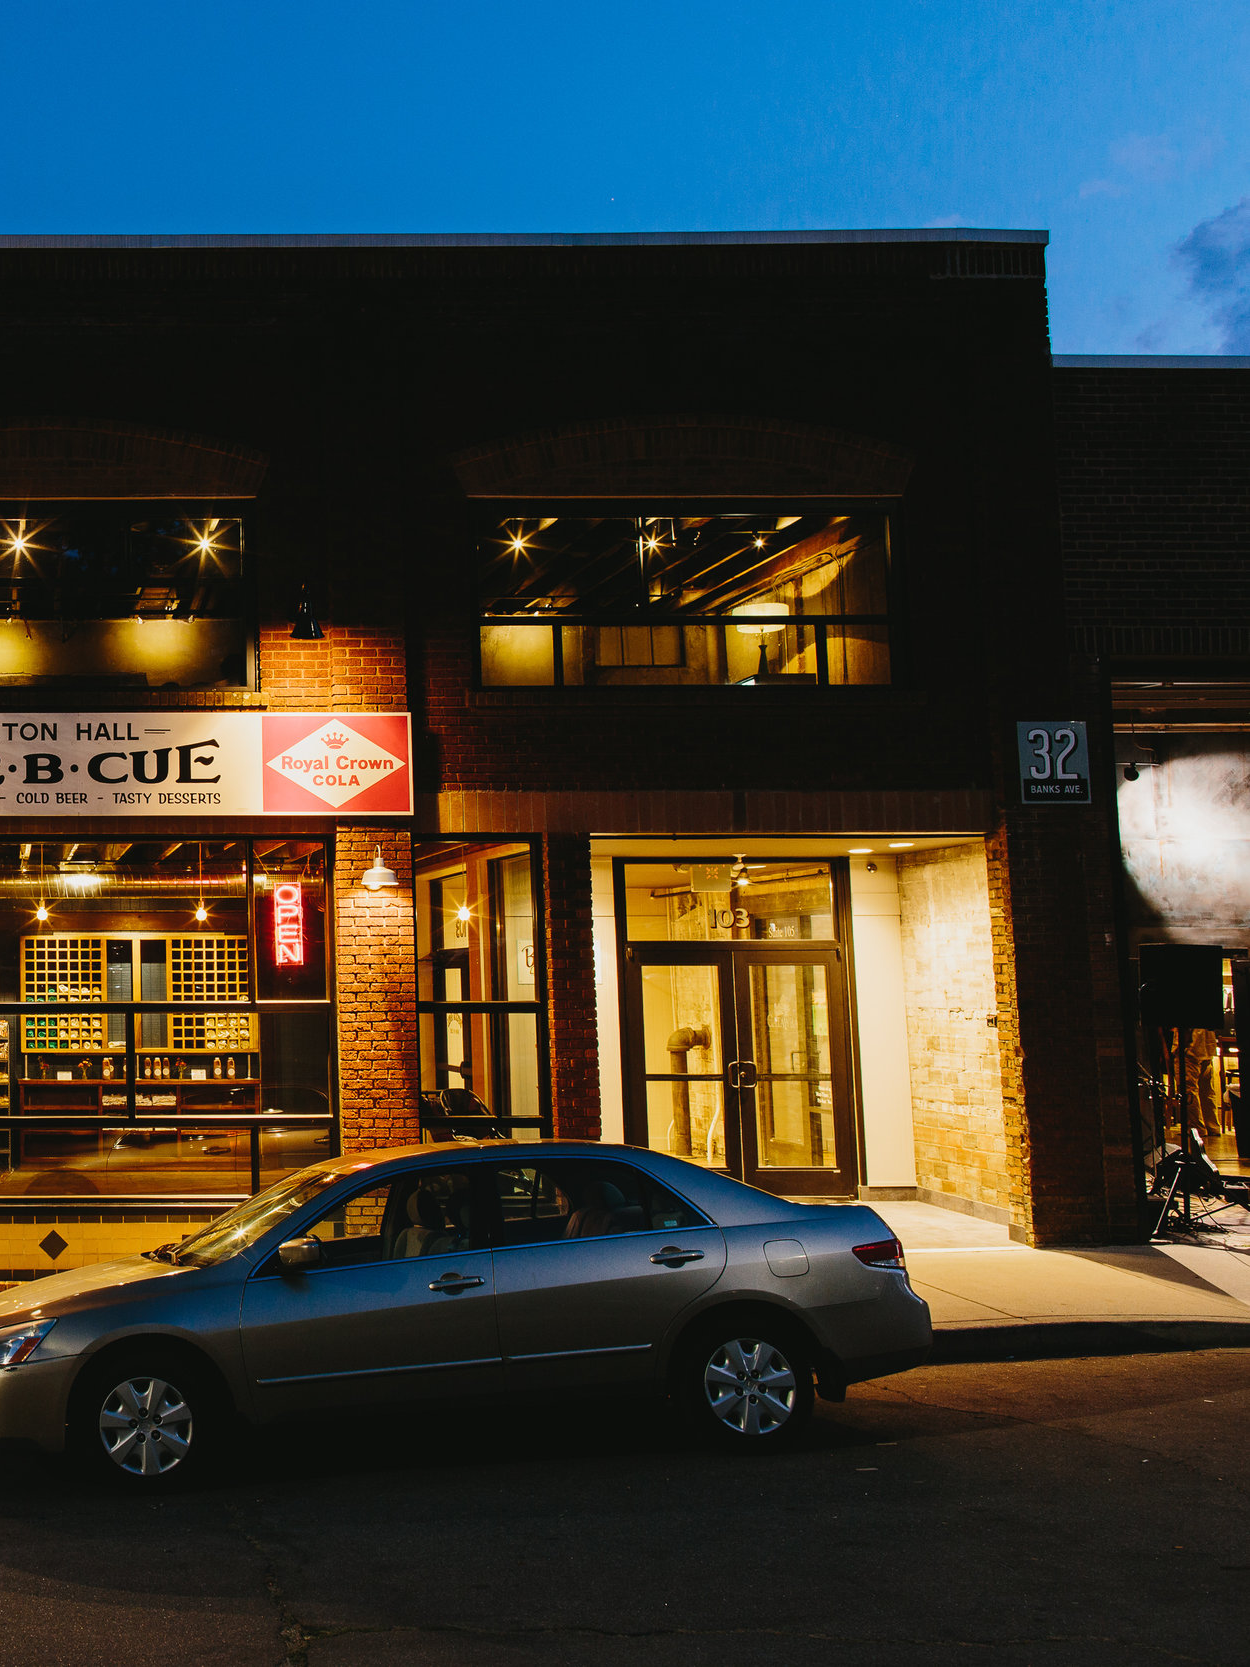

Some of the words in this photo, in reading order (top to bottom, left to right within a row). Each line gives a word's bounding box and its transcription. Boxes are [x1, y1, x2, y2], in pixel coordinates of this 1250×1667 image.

[76, 722, 139, 740] HALL
[1027, 728, 1079, 780] 32
[281, 755, 329, 773] Royal
[335, 755, 394, 770] Crown
[312, 774, 360, 786] COLA
[16, 792, 49, 804] COLD
[56, 792, 88, 804] BEER
[112, 792, 152, 804] TASTY
[158, 792, 221, 804] DESSERTS
[1031, 785, 1061, 794] BANKS
[276, 885, 301, 963] OPEN
[709, 907, 750, 929] 103
